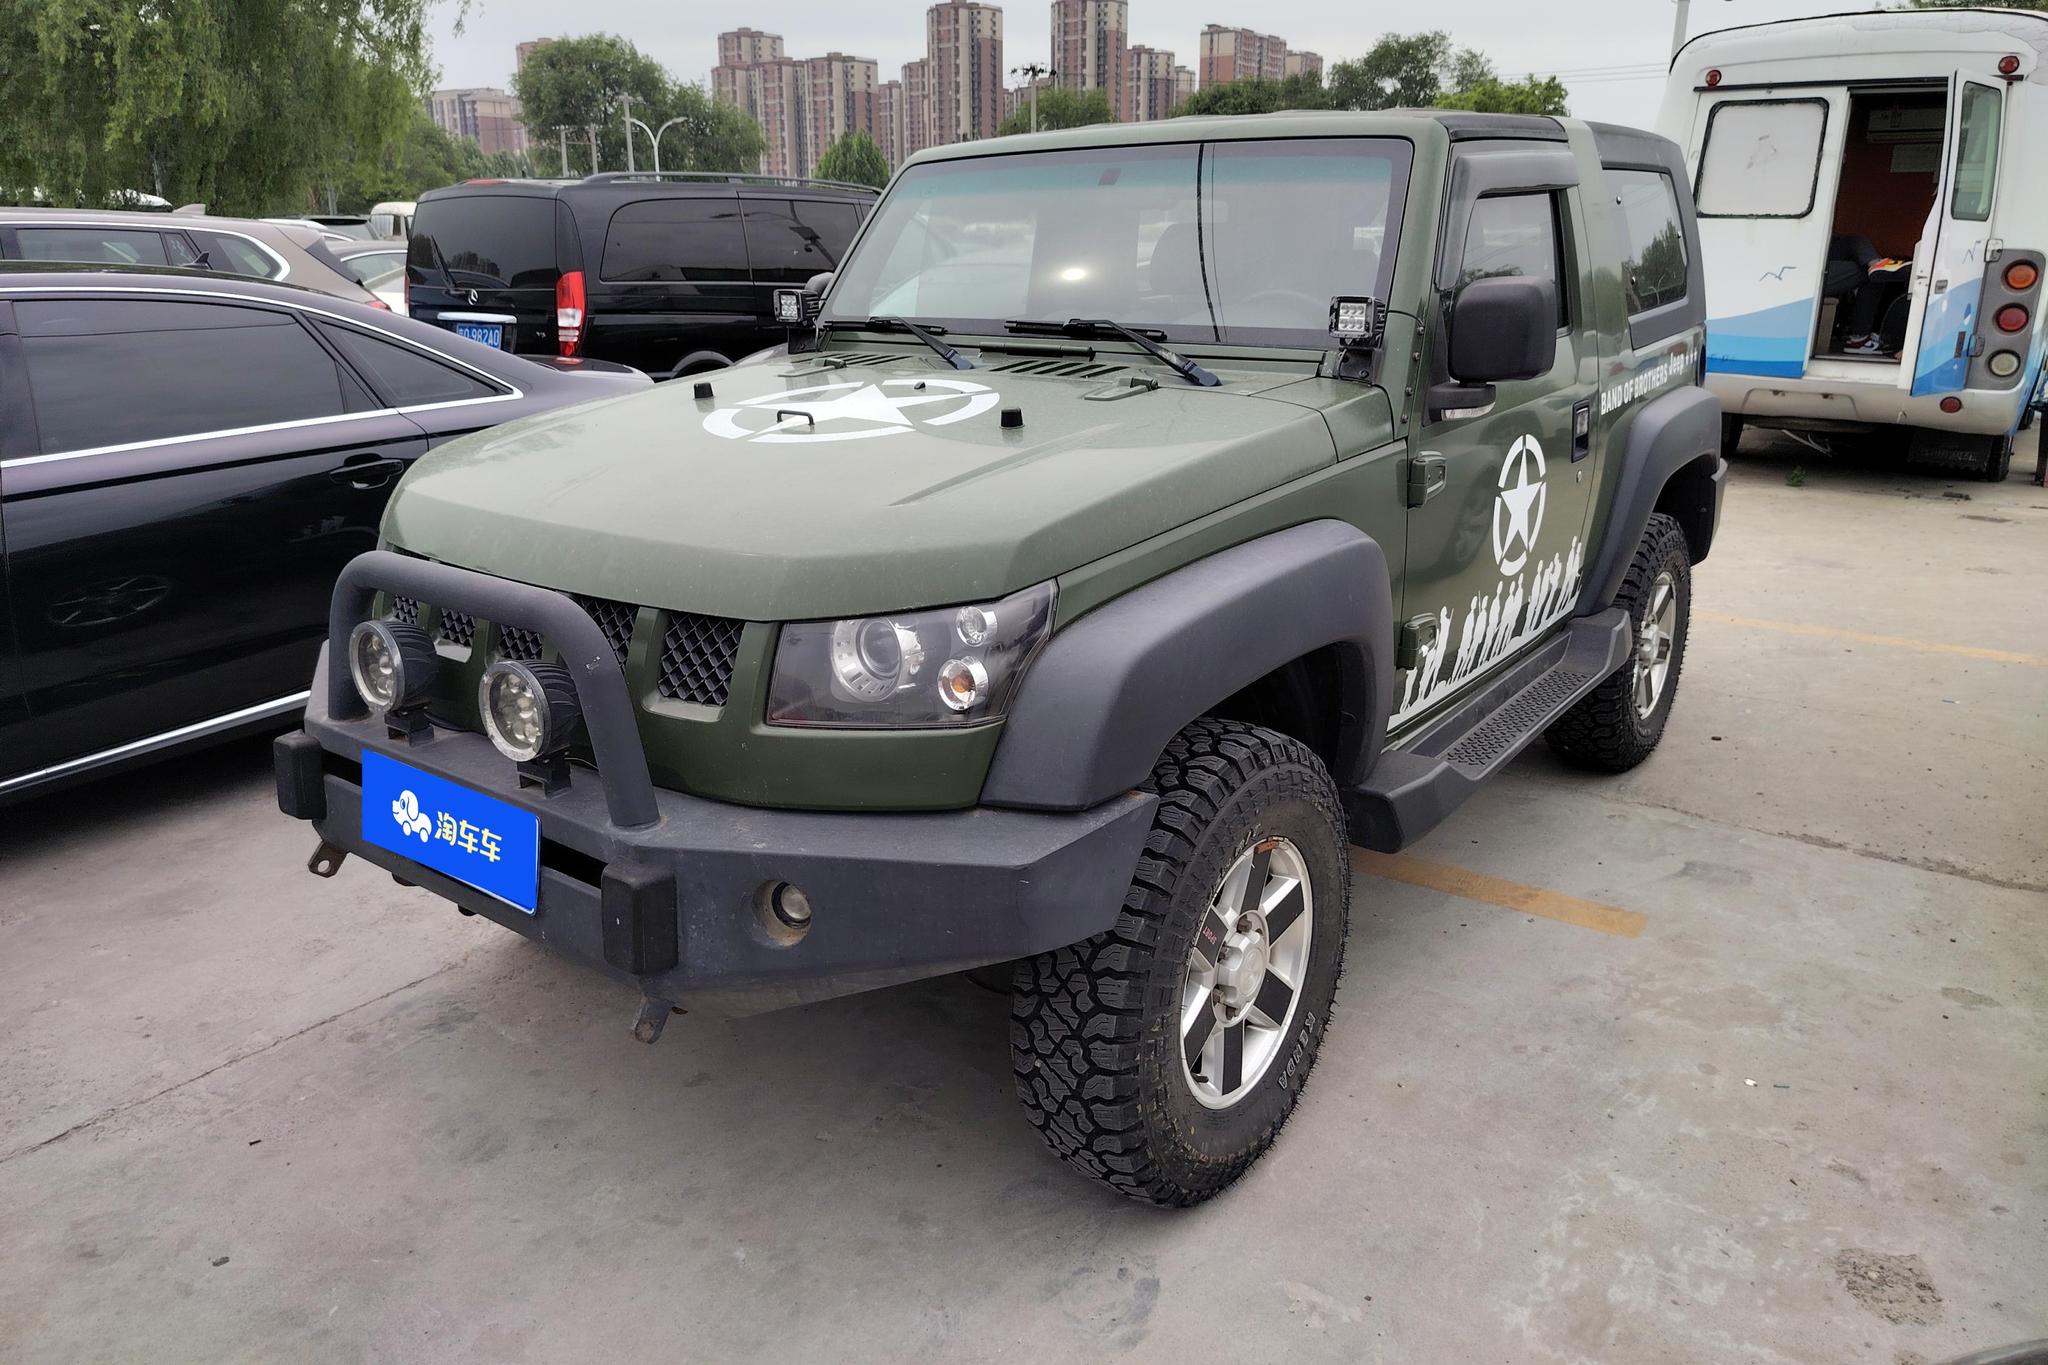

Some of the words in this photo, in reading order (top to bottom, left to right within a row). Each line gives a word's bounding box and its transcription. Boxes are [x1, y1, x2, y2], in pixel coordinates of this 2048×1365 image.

[1601, 385, 1622, 415] BAND
[1623, 380, 1633, 403] OF
[1634, 363, 1668, 398] BROTHERS
[1669, 352, 1684, 375] Jeep
[1278, 1011, 1316, 1090] KENDA
